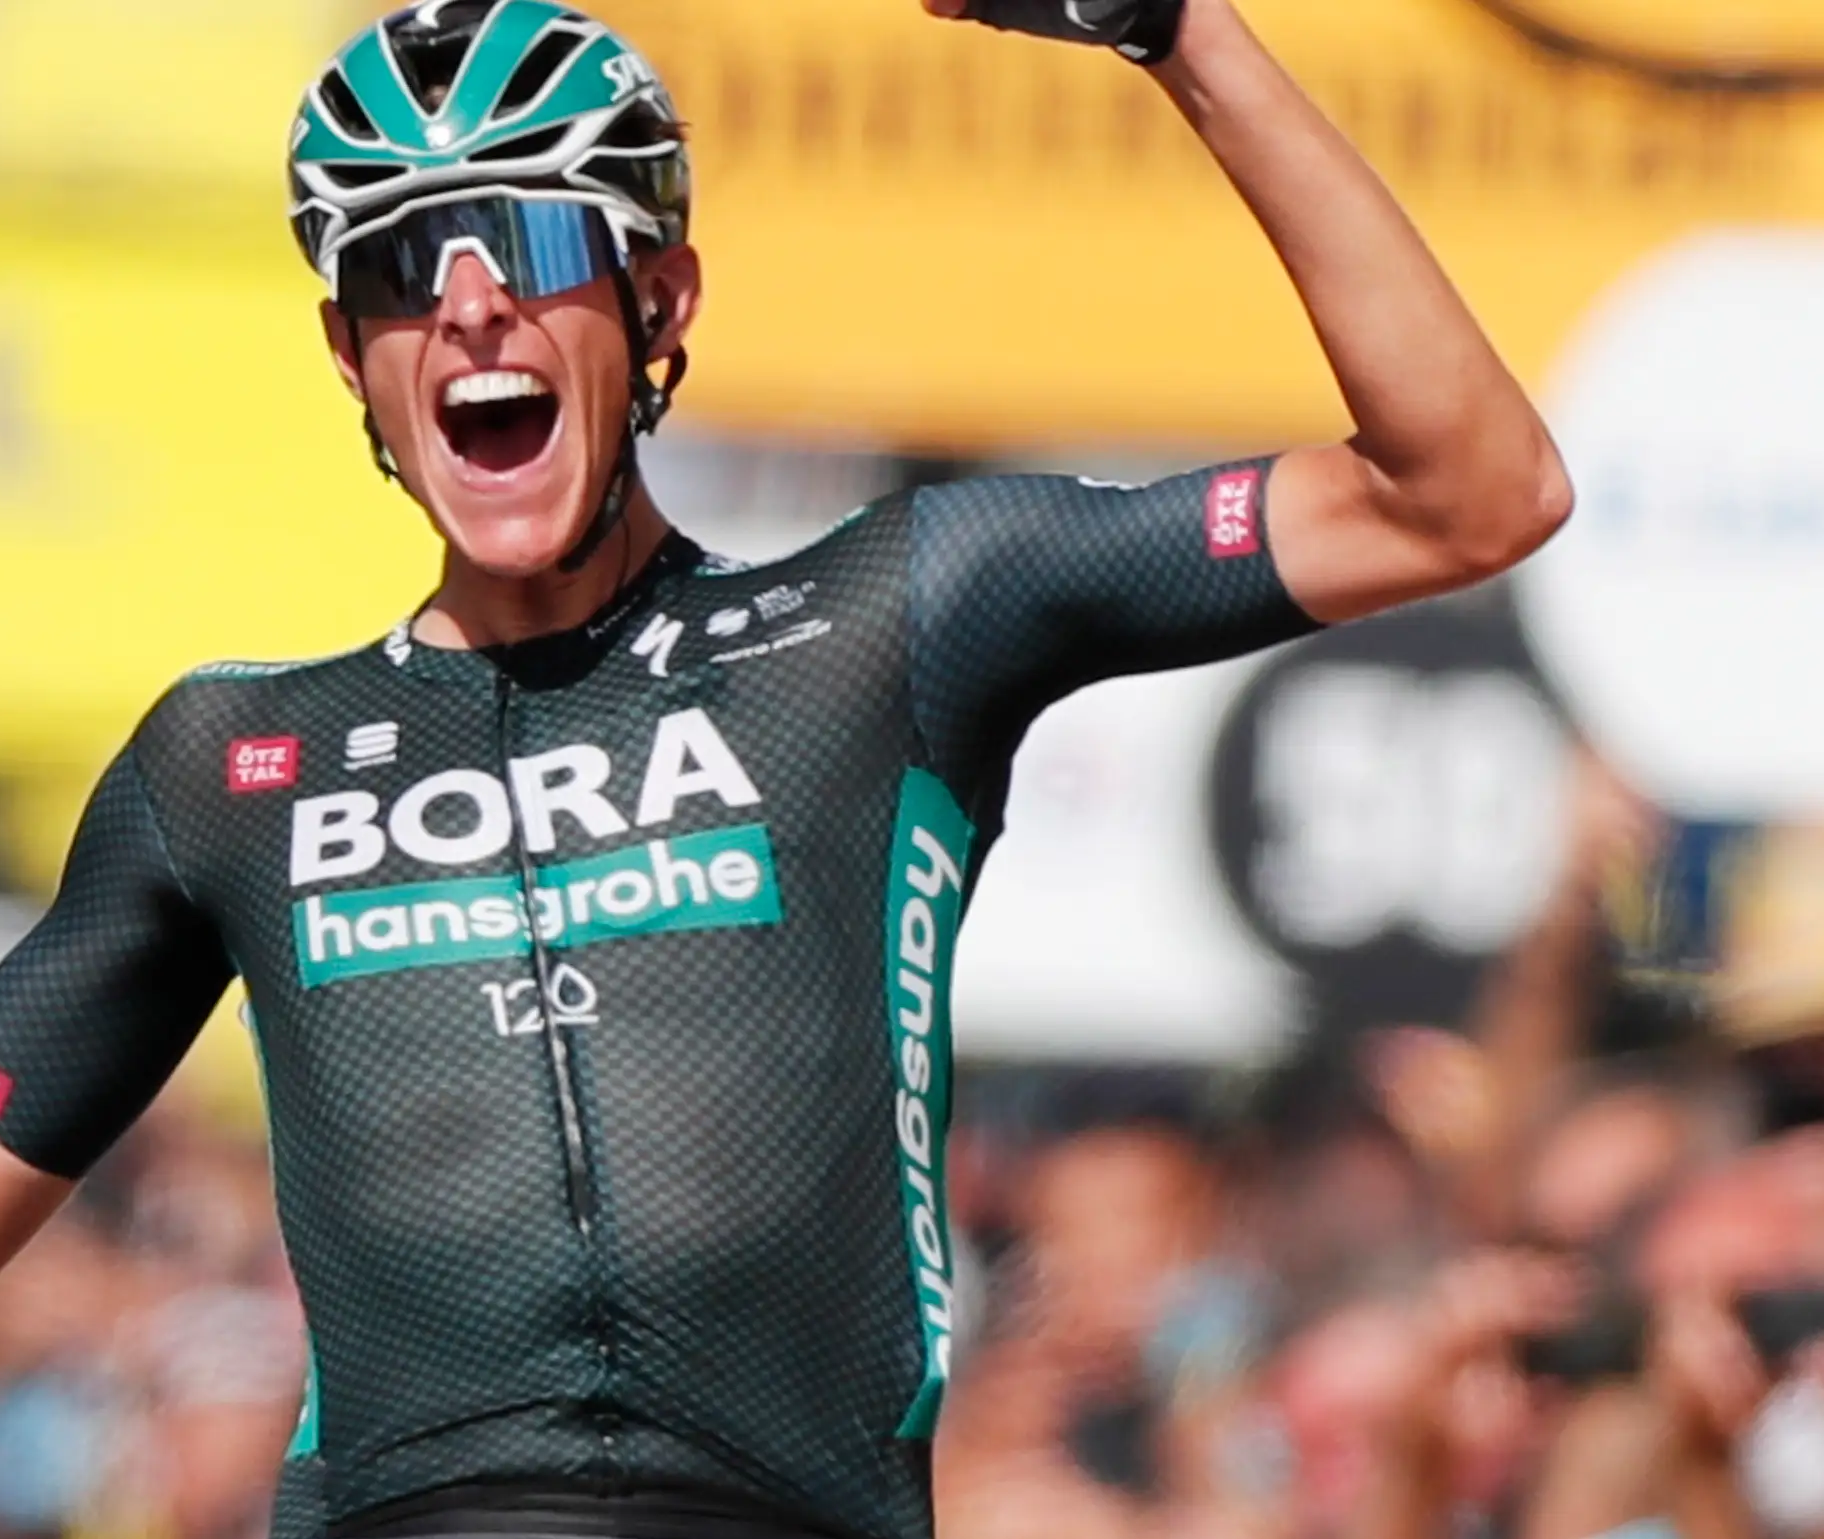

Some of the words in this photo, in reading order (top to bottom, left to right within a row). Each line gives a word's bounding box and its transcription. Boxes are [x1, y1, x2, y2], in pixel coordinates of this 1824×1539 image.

[236, 766, 286, 784] TAL
[289, 707, 763, 887] BORA
[305, 839, 760, 962] hansgrohe
